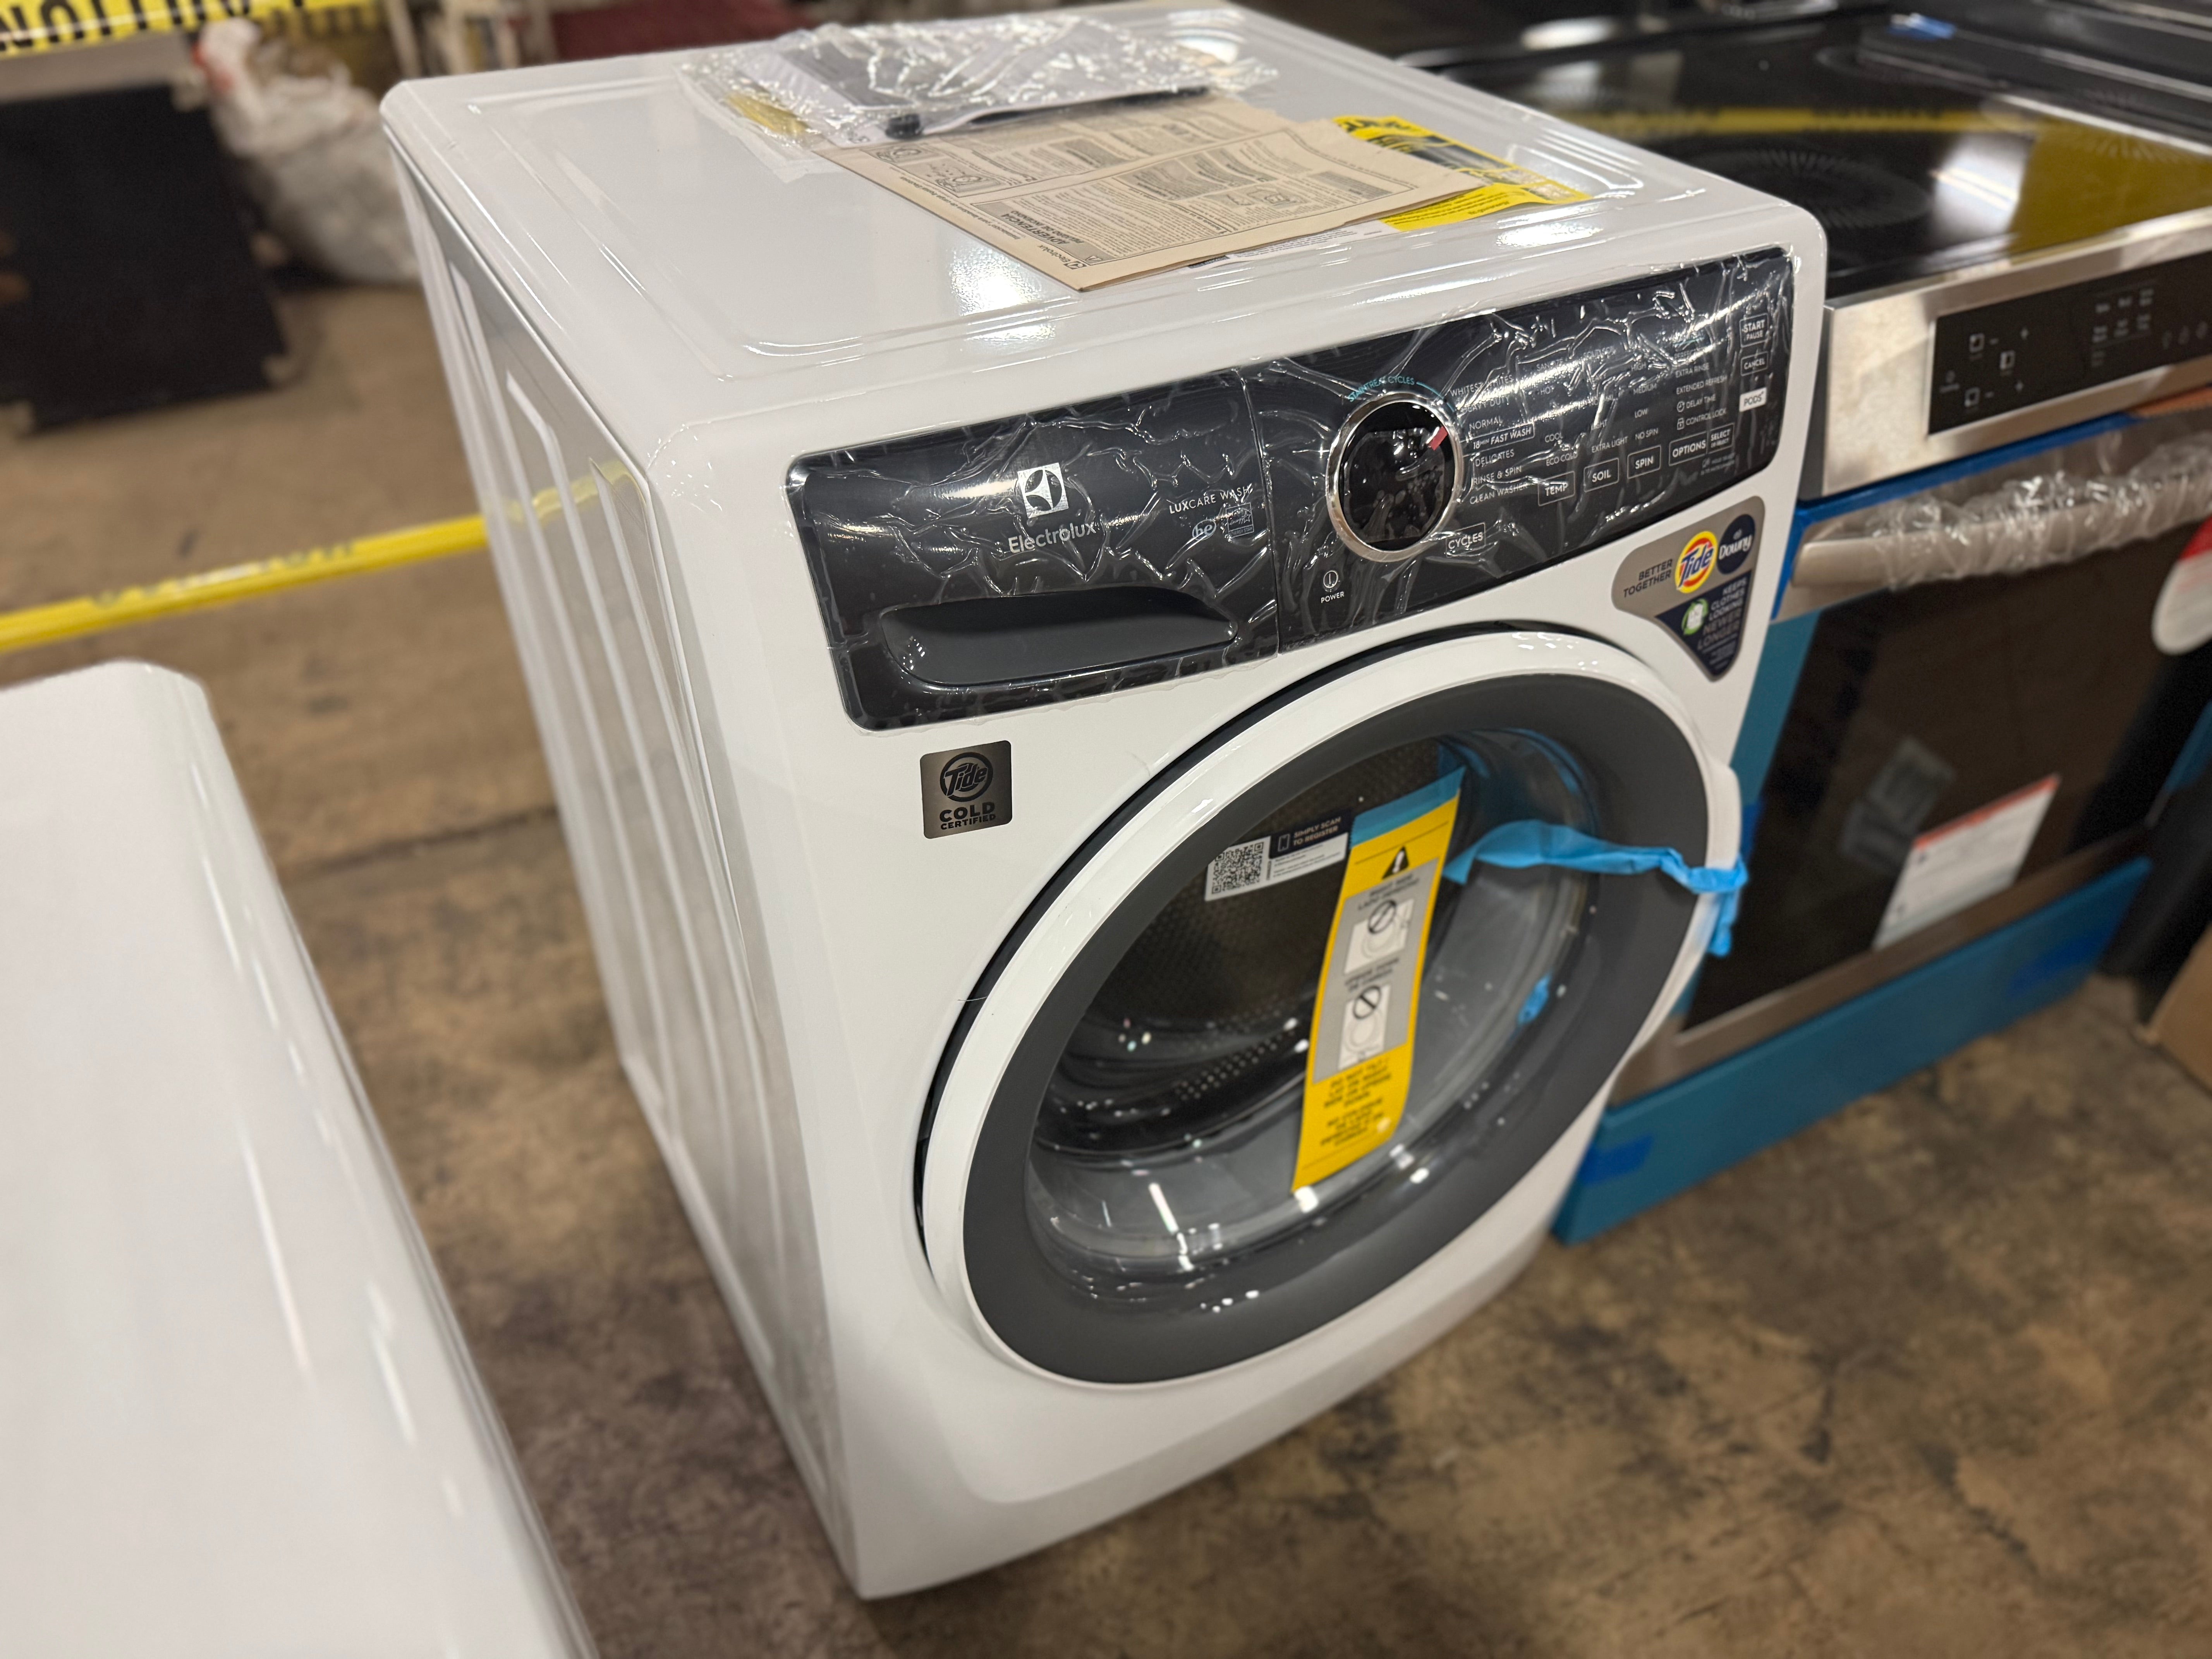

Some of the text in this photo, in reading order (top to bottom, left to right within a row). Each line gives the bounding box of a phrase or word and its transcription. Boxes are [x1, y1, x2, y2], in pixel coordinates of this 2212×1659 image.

[1001, 213, 1070, 245] ADVERTENCIA
[1037, 244, 1071, 263] Electrolux
[1743, 319, 1765, 333] START
[1747, 330, 1763, 341] PAUSE
[1631, 362, 1646, 371] HIGH
[1675, 362, 1710, 378] EXTRA RINSE
[1744, 358, 1765, 370] CANCEL
[1388, 376, 1415, 385] CYCLES
[1450, 382, 1483, 397] WHITEST
[1633, 383, 1657, 395] MEDIUM
[1676, 375, 1728, 395] EXTENDED REFRESH
[1540, 387, 1554, 395] HOT
[1490, 395, 1509, 407] DUTY
[1686, 393, 1717, 409] DELAY TIME
[1635, 408, 1649, 418] LOW
[1686, 408, 1727, 426] CONTROL LOCK
[1469, 415, 1503, 431] NORMAL
[1491, 433, 1508, 445] FAST
[1510, 427, 1531, 439] WASH
[1545, 432, 1563, 443] COOL
[1635, 427, 1659, 441] NO SPIN
[1711, 429, 1731, 441] SELECT
[1591, 436, 1629, 453] EXTRA LIGHT
[1672, 440, 1706, 458] OPTIONS
[1475, 449, 1515, 467] DELICATES
[1546, 452, 1578, 467] ECO COLD
[1635, 455, 1654, 470] SPIN
[1473, 466, 1522, 485] RINSE & SPIN
[1592, 469, 1611, 483] SOIL
[1470, 482, 1528, 505] CLEAN WASHER
[1545, 483, 1568, 496] TEMP
[1169, 486, 1250, 514] LUXCARE WASH
[1008, 521, 1097, 553] Electrolux
[1448, 531, 1483, 550] CYCLES
[1718, 534, 1753, 560] Downy
[1638, 558, 1673, 581] BETTER
[1677, 543, 1716, 589] Tide
[1623, 570, 1671, 598] TOGETHER
[1723, 577, 1748, 596] KEEPS
[1321, 591, 1345, 604] POWER
[1711, 589, 1745, 611] CLOTHES
[1709, 598, 1743, 620] LOOKING
[1697, 622, 1740, 652] LONGER
[943, 762, 988, 797] Tide
[939, 801, 995, 822] COLD
[940, 814, 996, 830] CERTIFIED
[1293, 816, 1341, 839] SIMPLY SCAN
[1293, 825, 1339, 847] TO REGISTER
